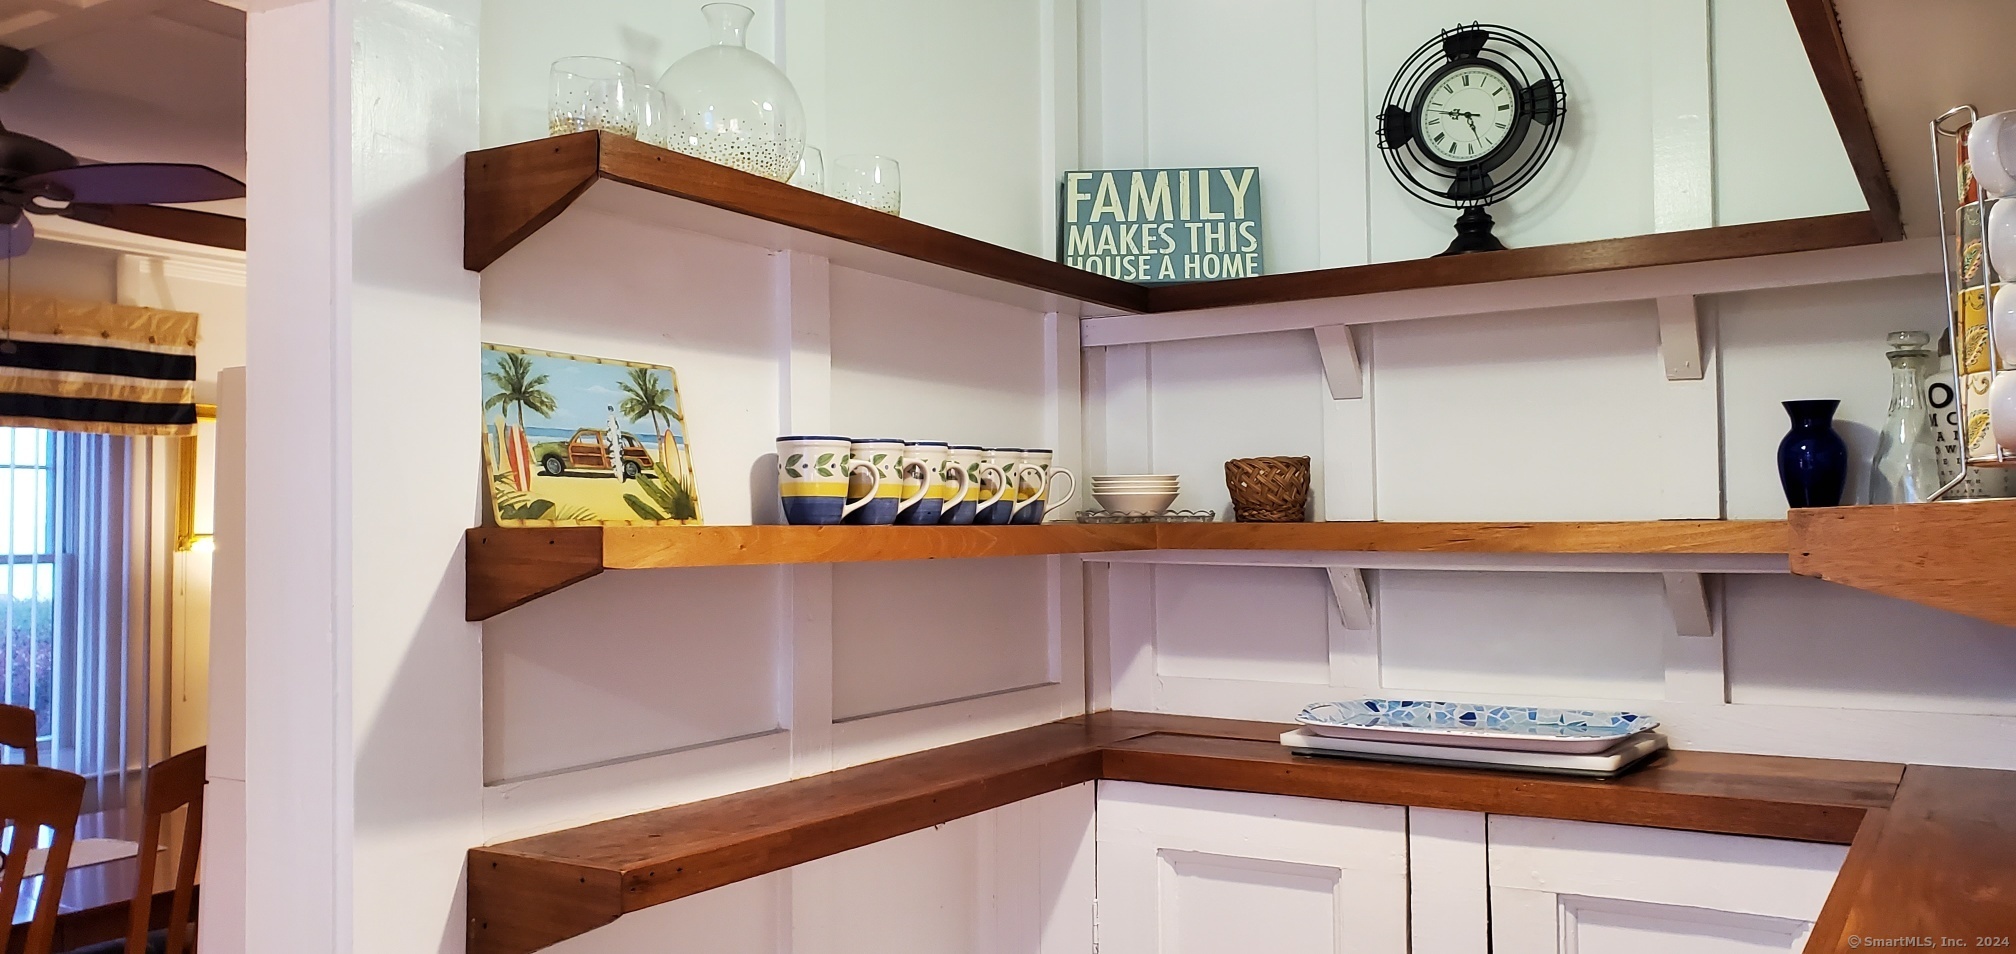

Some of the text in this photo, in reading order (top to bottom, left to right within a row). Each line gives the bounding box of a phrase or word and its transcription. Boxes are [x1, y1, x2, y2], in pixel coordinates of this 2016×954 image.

[1067, 168, 1256, 223] FAMILY
[1067, 221, 1258, 256] MAKES THIS
[1158, 255, 1176, 280] A
[1184, 253, 1259, 279] HOME
[1928, 382, 1954, 409] O
[1937, 431, 1945, 442] A
